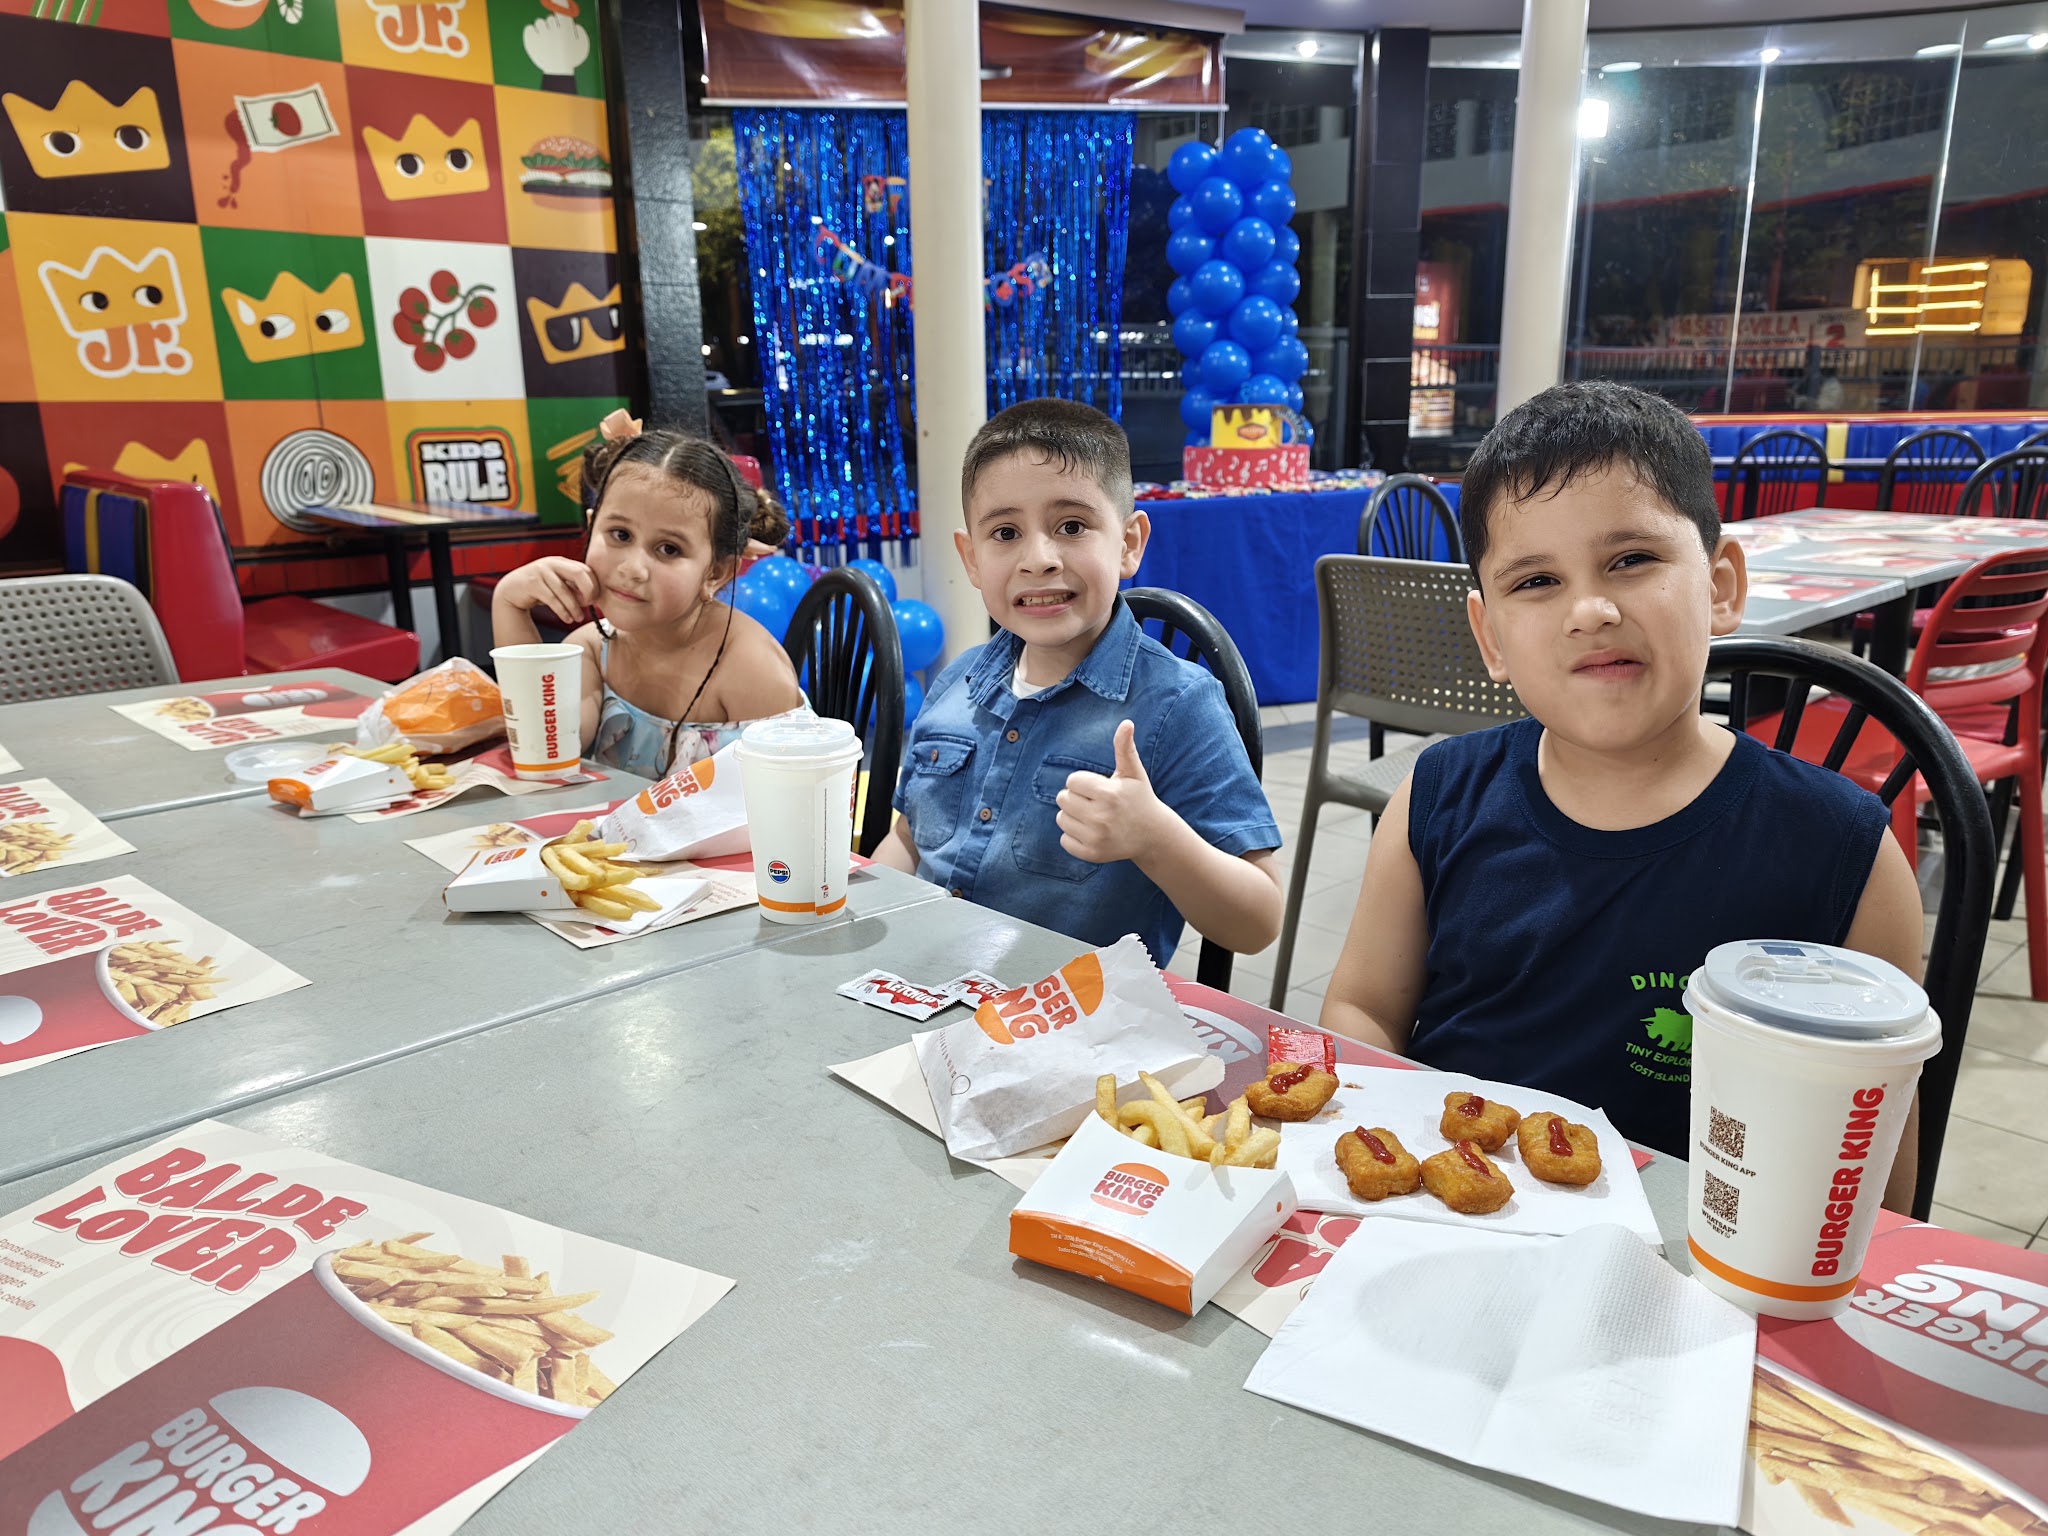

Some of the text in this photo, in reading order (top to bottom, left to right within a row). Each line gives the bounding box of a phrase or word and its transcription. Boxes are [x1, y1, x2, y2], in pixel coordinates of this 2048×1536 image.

[380, 2, 466, 54] Jr.
[82, 321, 189, 374] Jr.
[421, 441, 502, 460] KIDS
[423, 459, 509, 504] RULE
[542, 673, 559, 760] BURGER KING
[769, 868, 790, 876] PEPSI
[0, 899, 108, 956] LOVER
[47, 886, 163, 938] BALDE
[881, 981, 940, 1004] KETCHUP
[1625, 1041, 1653, 1058] TINY
[1629, 1060, 1691, 1083] LOST ISLAND
[1103, 1169, 1165, 1197] BURGER
[1720, 1156, 1739, 1171] KING
[1739, 1166, 1757, 1178] APP
[1811, 1086, 1886, 1277] BURGER KING
[113, 1146, 369, 1244] BALDE
[1093, 1179, 1158, 1209] KING
[1701, 1207, 1738, 1236] WHATSAPP
[1712, 1224, 1725, 1236] REY
[24, 1249, 65, 1269] supremas
[32, 1185, 297, 1296] LOVER
[70, 1440, 265, 1536] KIN
[151, 1407, 327, 1535] BURGER
